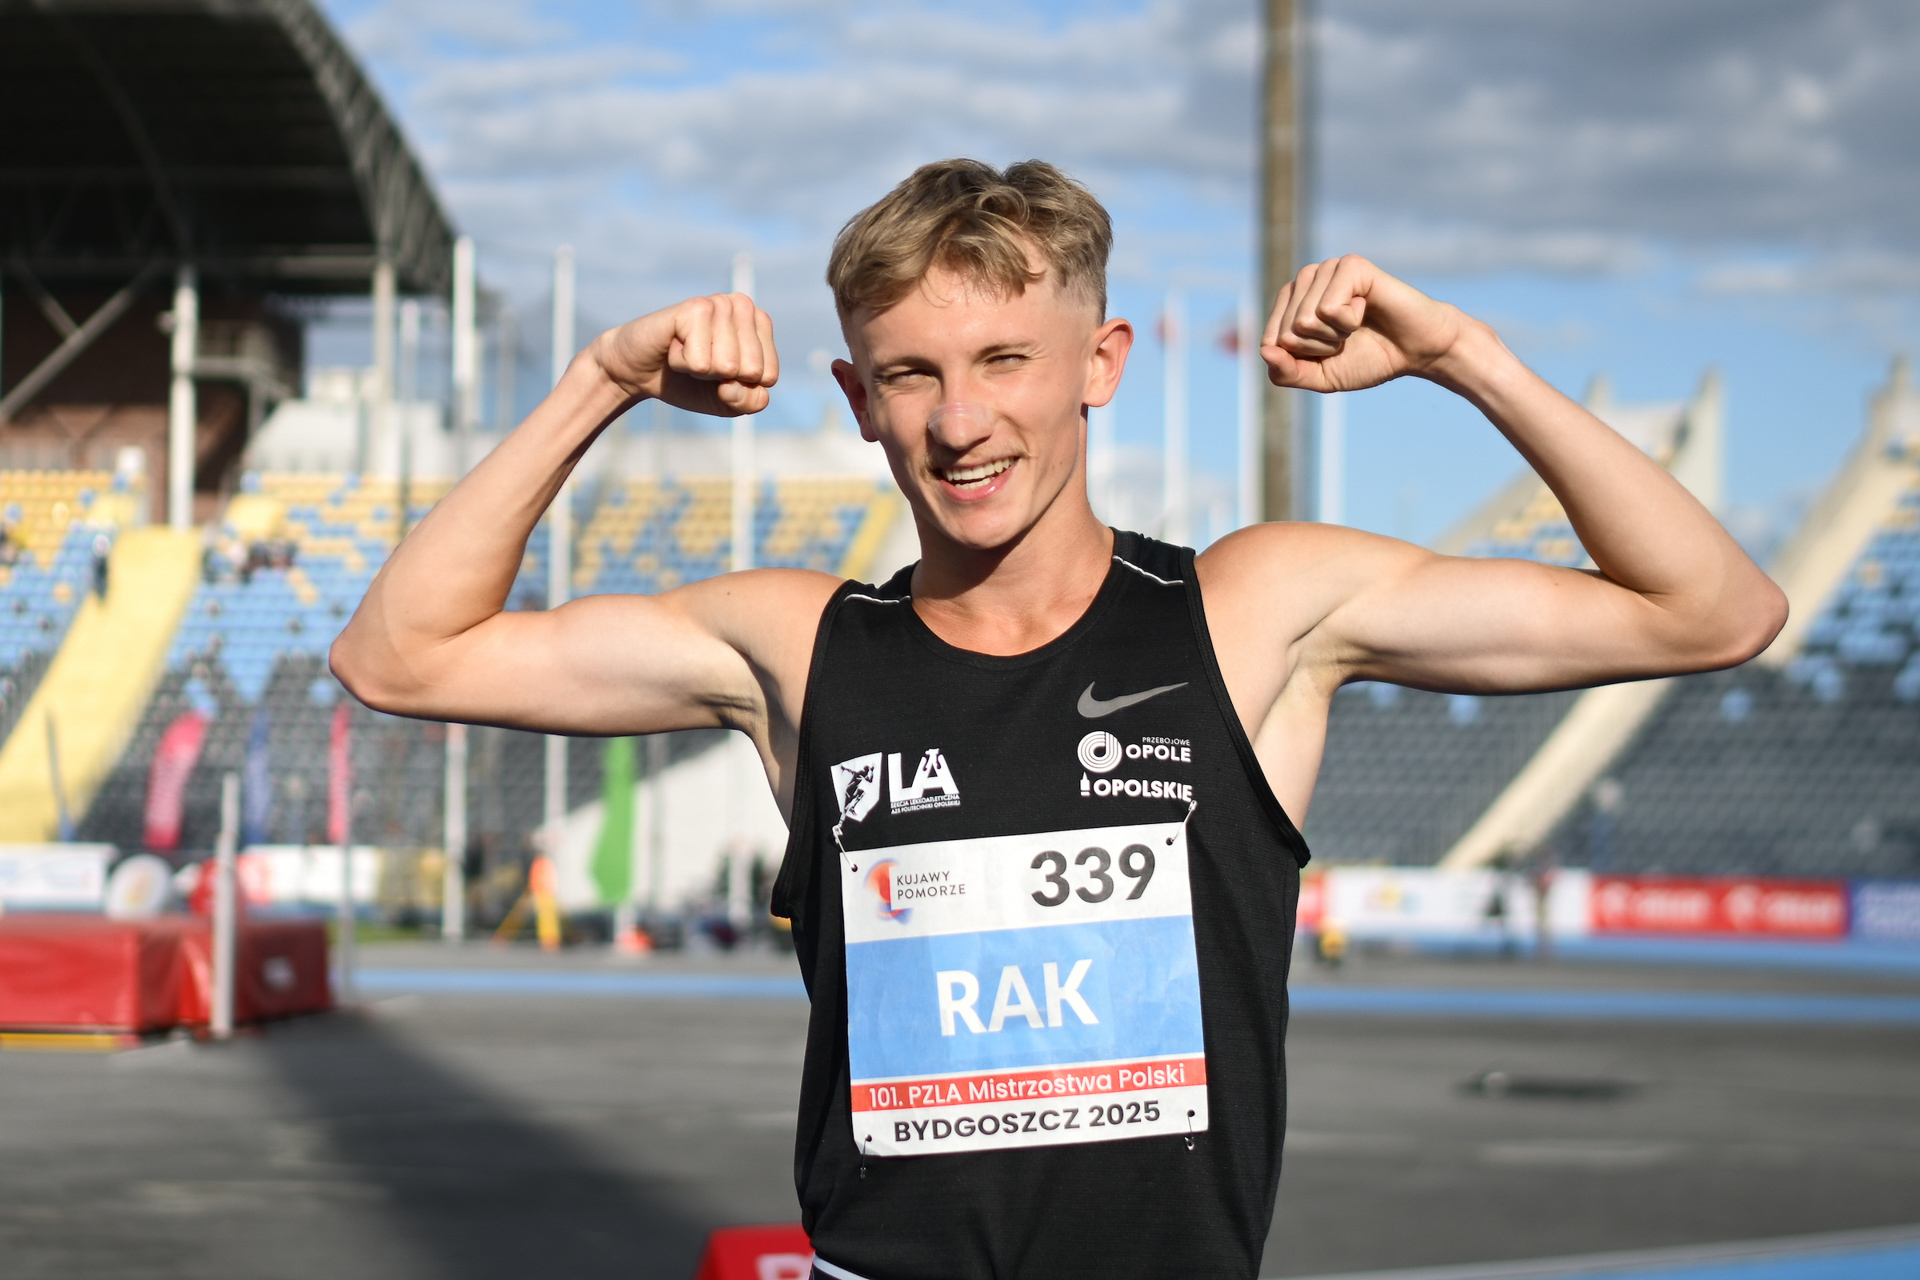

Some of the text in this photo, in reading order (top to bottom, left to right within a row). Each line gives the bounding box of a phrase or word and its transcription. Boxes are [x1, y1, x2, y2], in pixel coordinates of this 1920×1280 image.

[1125, 744, 1192, 763] OPOLE
[1142, 736, 1191, 746] PRZEBOJOWE
[1093, 778, 1193, 803] OPOLSKIE
[896, 870, 951, 886] KUJAWY
[1030, 843, 1156, 907] 339
[897, 883, 967, 900] POMORZE
[936, 959, 1100, 1037] RAK
[869, 1062, 1186, 1108] 101. PZLA Mistrzostwa Polski
[894, 1100, 1161, 1143] BYDGOSZCZ 2025
